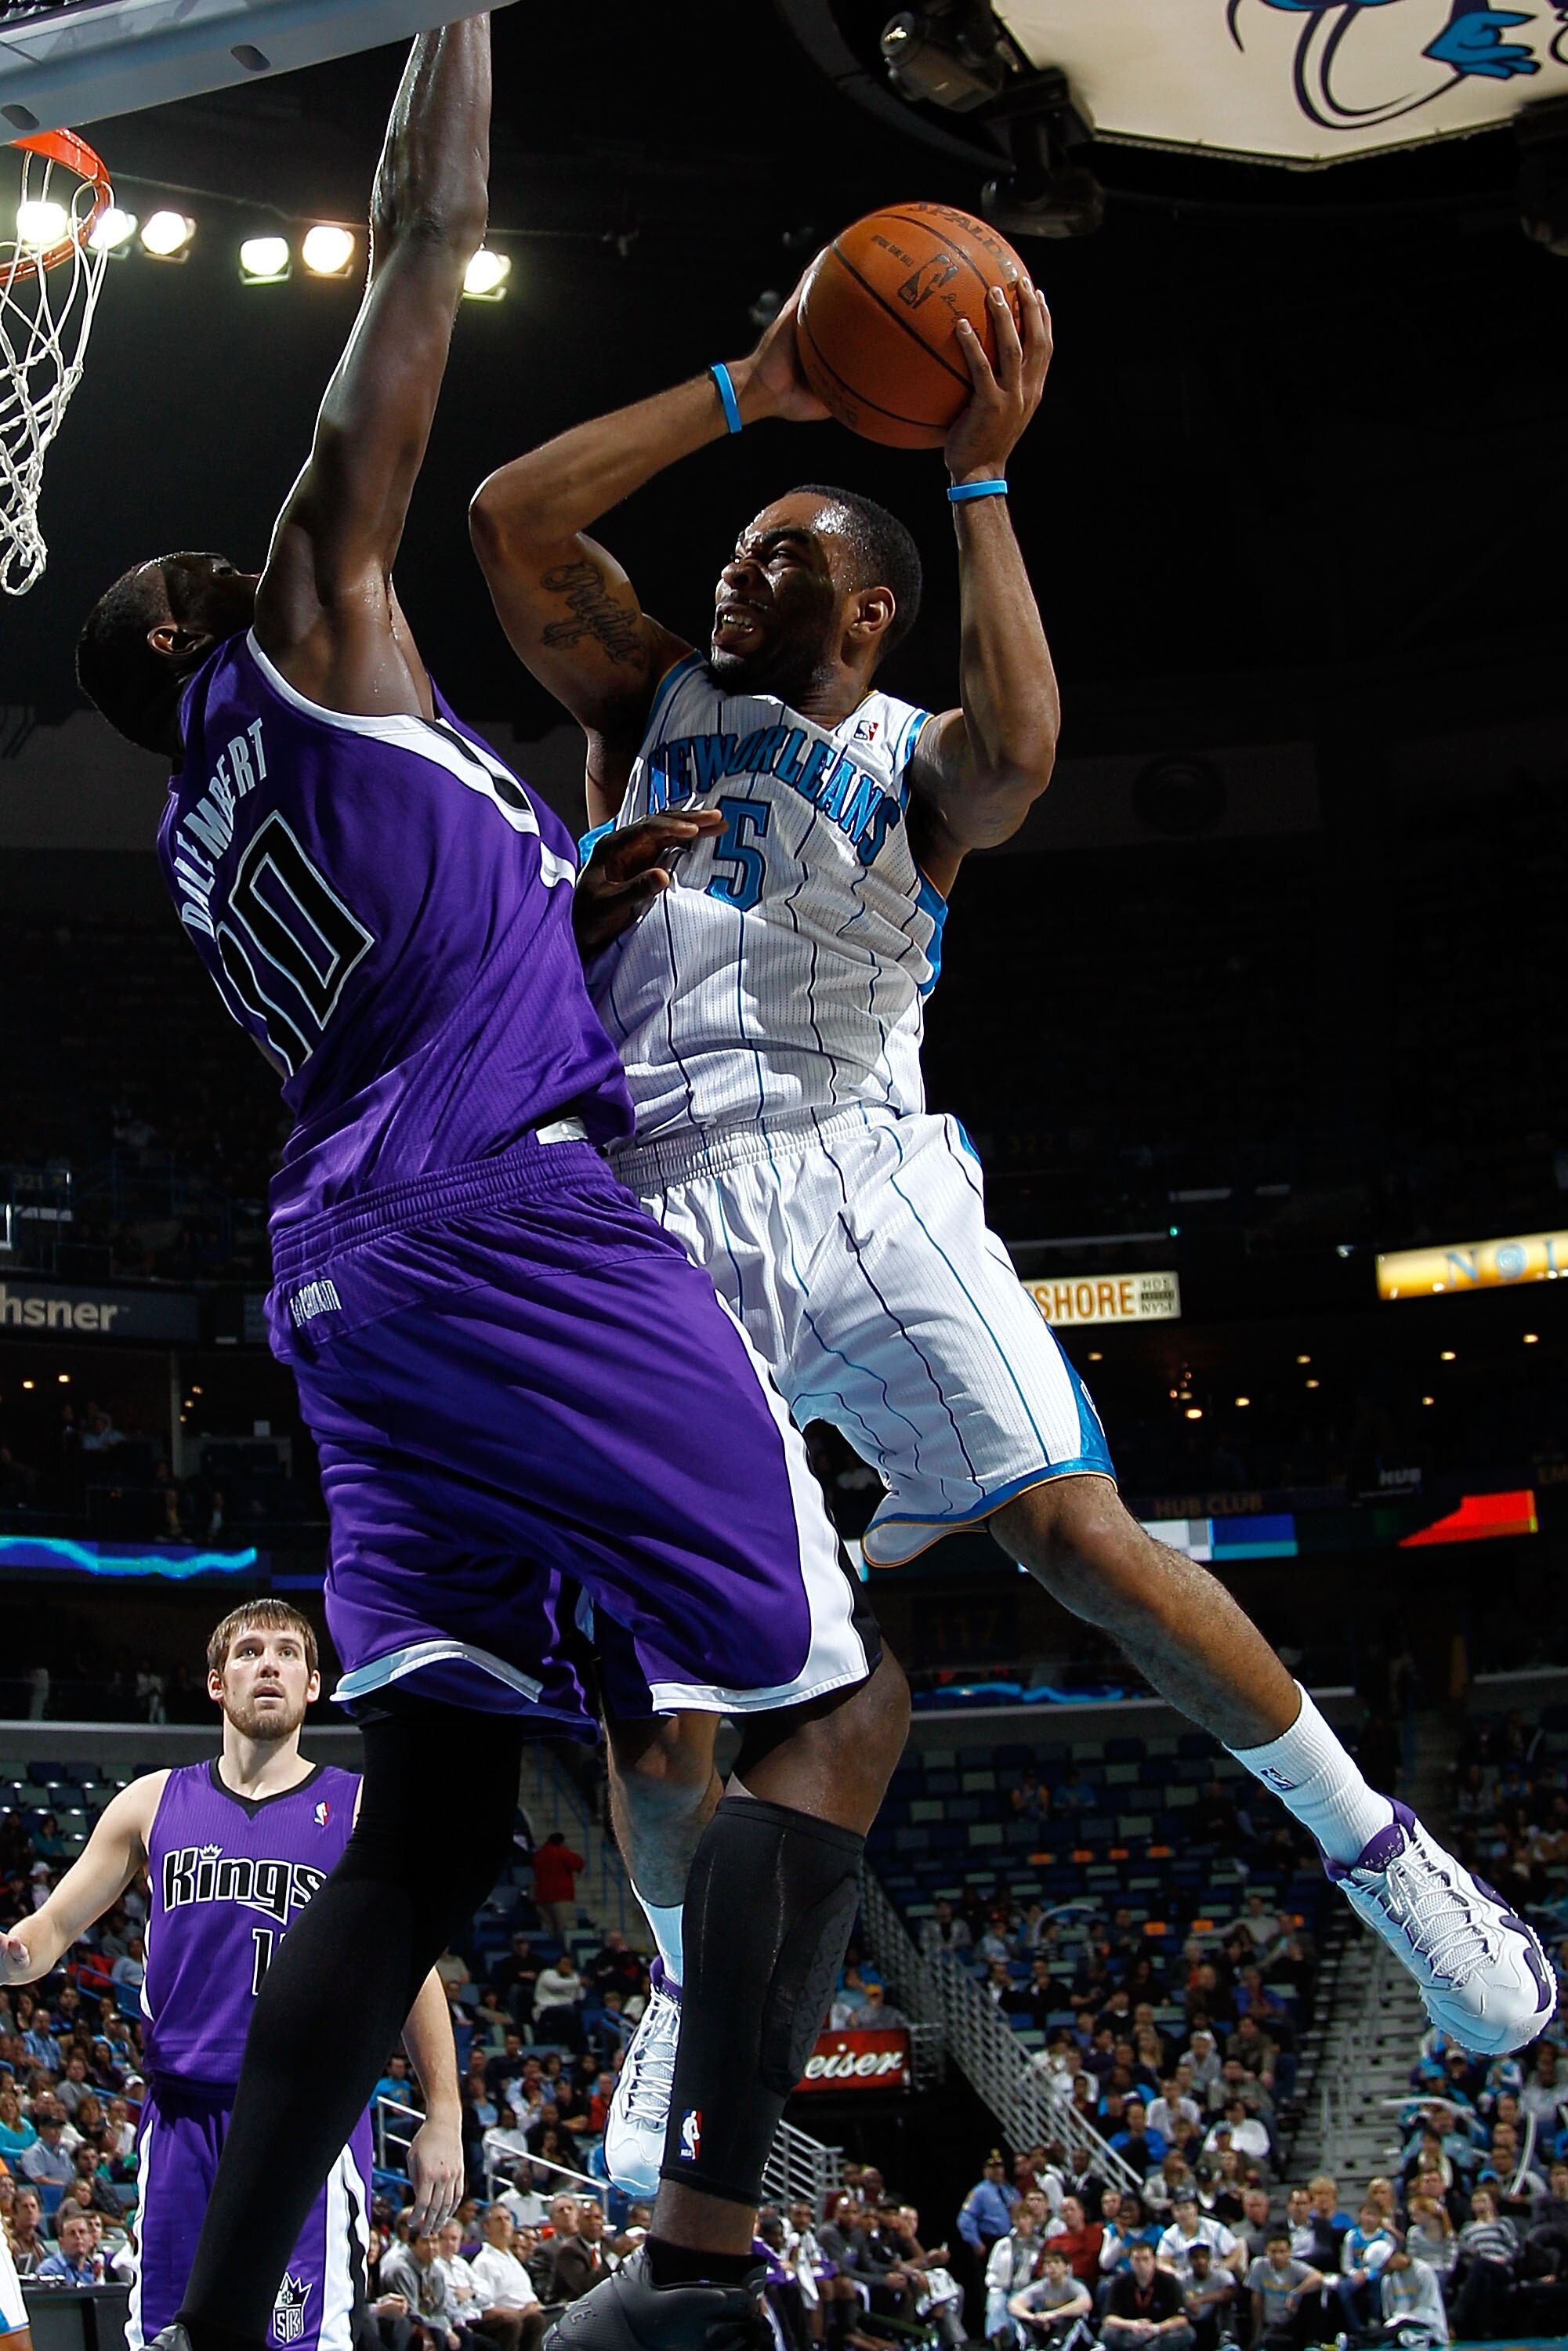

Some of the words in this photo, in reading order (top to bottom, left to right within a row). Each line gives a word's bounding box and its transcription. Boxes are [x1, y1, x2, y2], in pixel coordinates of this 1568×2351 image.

[174, 717, 267, 942] DALEMBERT
[646, 734, 739, 817] NEW
[724, 725, 901, 867] ORLEANS
[706, 795, 772, 913] 5
[216, 810, 375, 1077] 10
[0, 1282, 118, 1331] hsner
[1029, 1281, 1135, 1320] SHORE
[163, 1843, 328, 1925] Kings
[252, 1928, 287, 1995] 1
[804, 2042, 904, 2081] eiser
